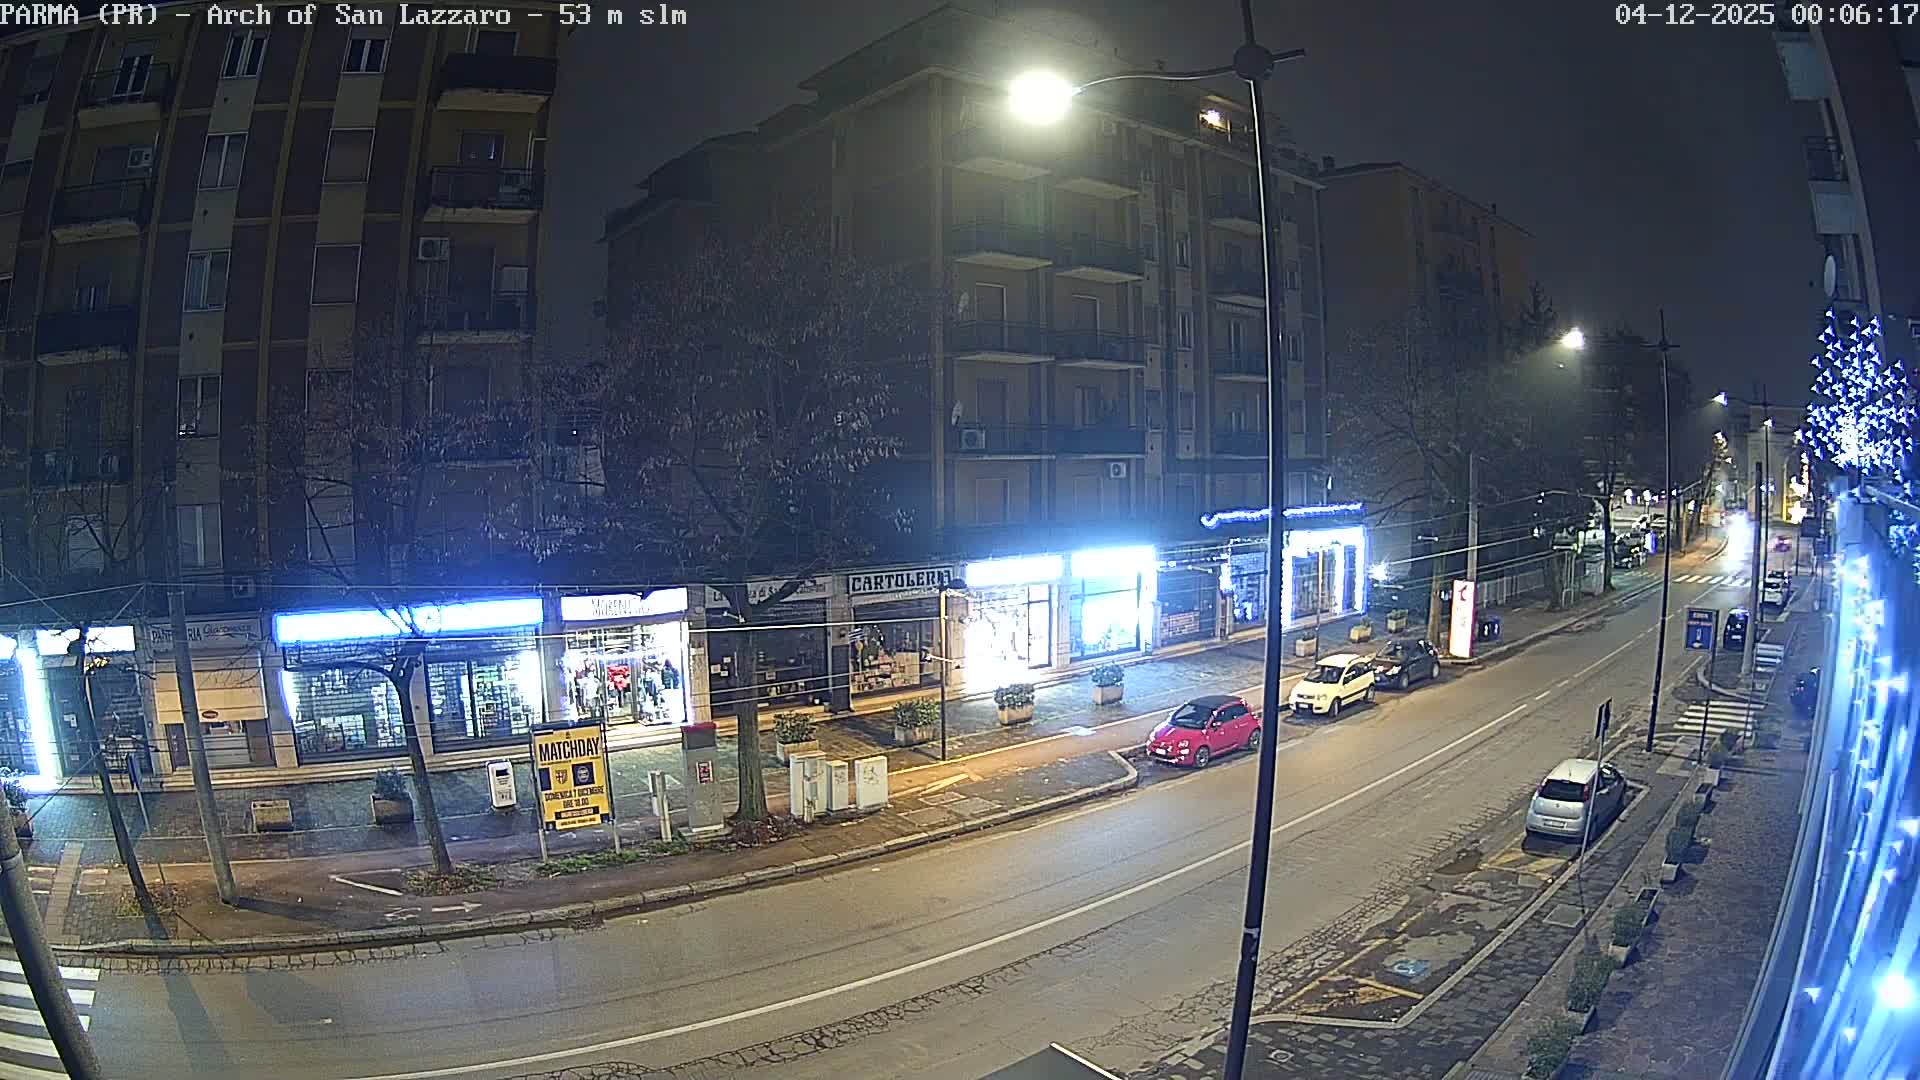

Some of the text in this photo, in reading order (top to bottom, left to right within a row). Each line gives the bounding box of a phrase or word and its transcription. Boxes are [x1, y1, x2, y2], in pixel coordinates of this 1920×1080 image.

[850, 569, 951, 591] CARTOLERIA
[538, 737, 600, 761] MATCHDAY
[545, 790, 572, 802] DOMENICA
